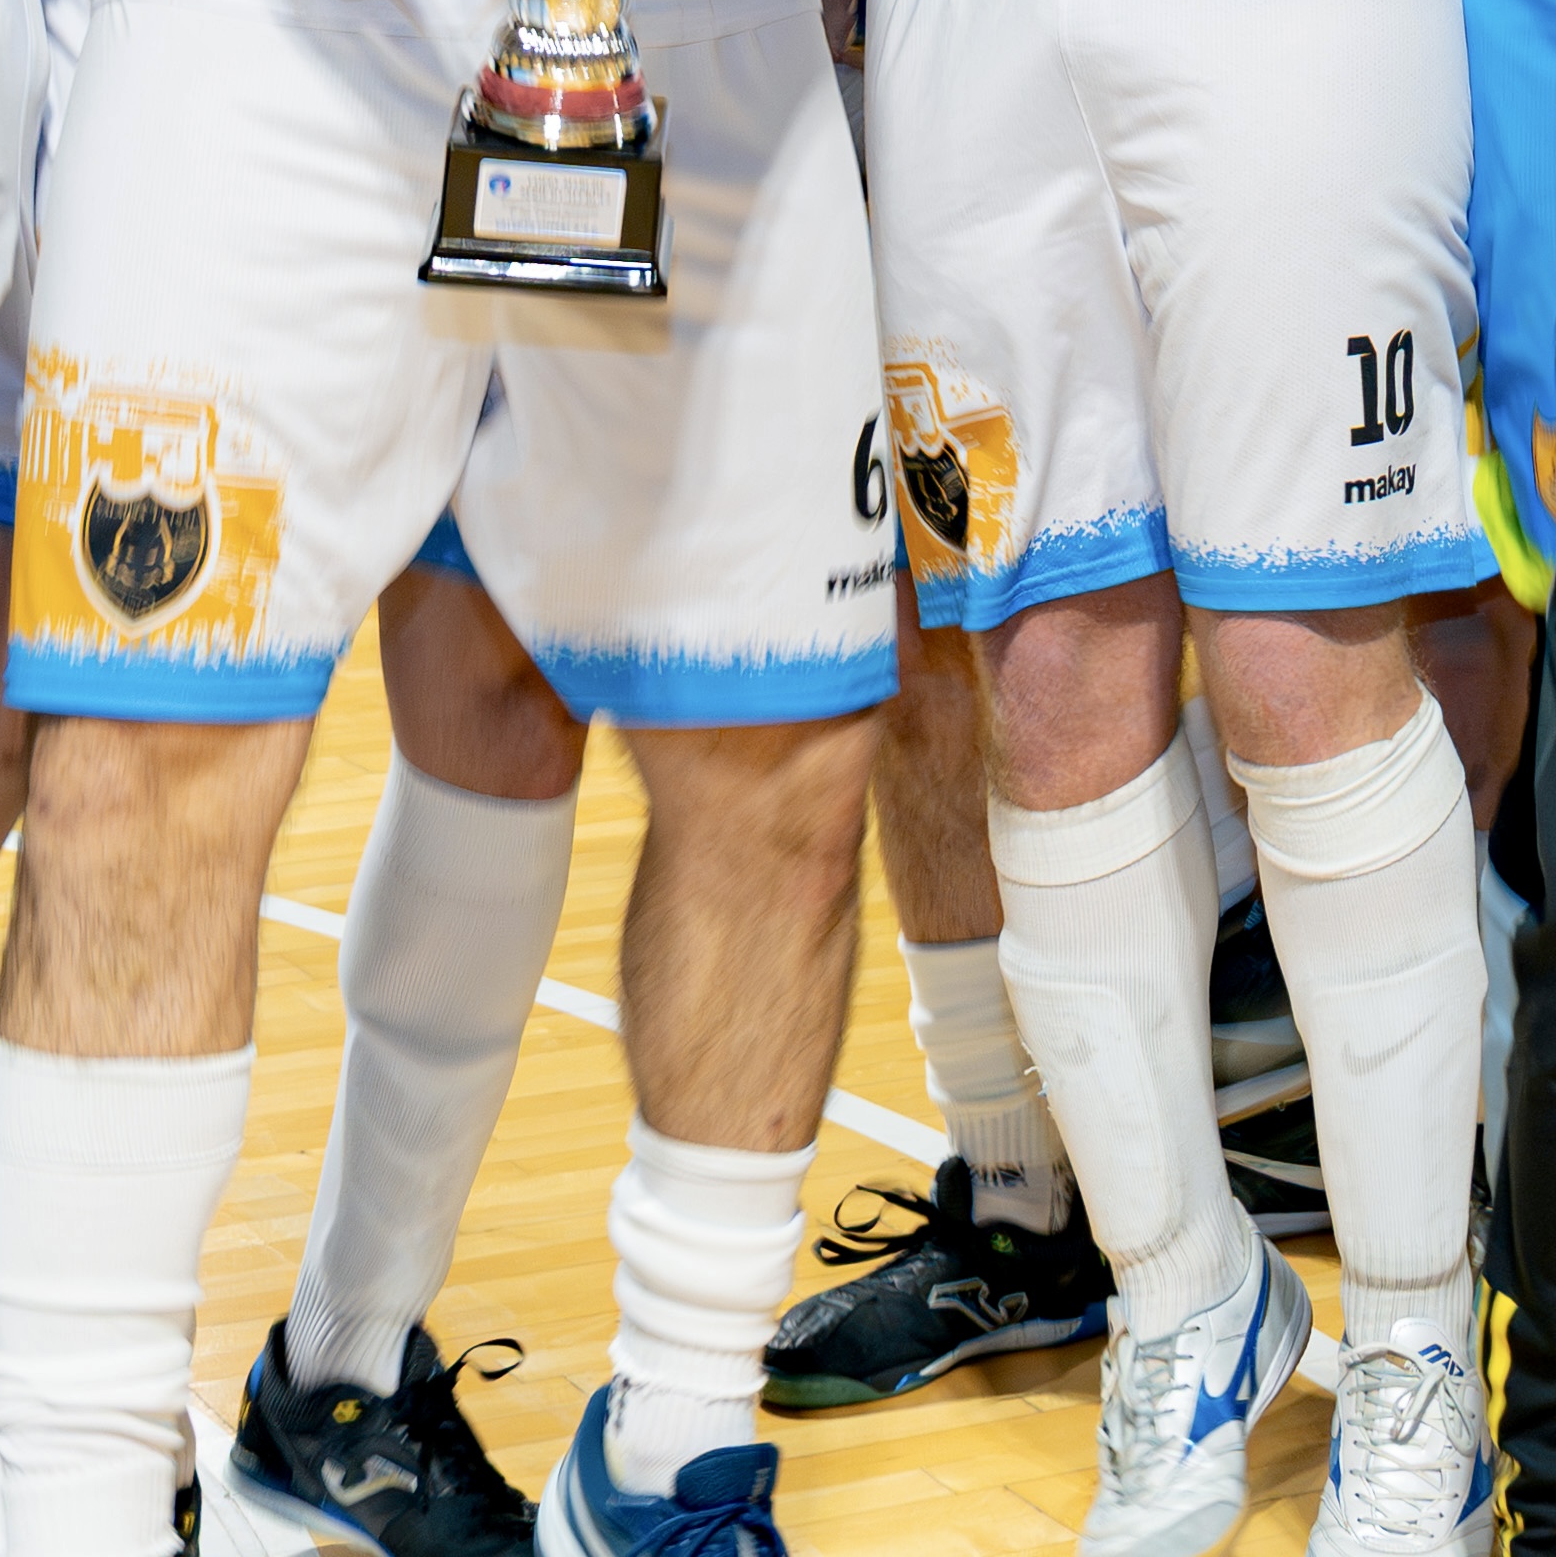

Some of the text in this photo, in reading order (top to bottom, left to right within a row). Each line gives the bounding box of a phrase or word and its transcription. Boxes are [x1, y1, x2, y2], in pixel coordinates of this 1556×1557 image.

[1345, 327, 1415, 447] 10
[851, 409, 888, 531] 6
[1343, 463, 1417, 505] makay
